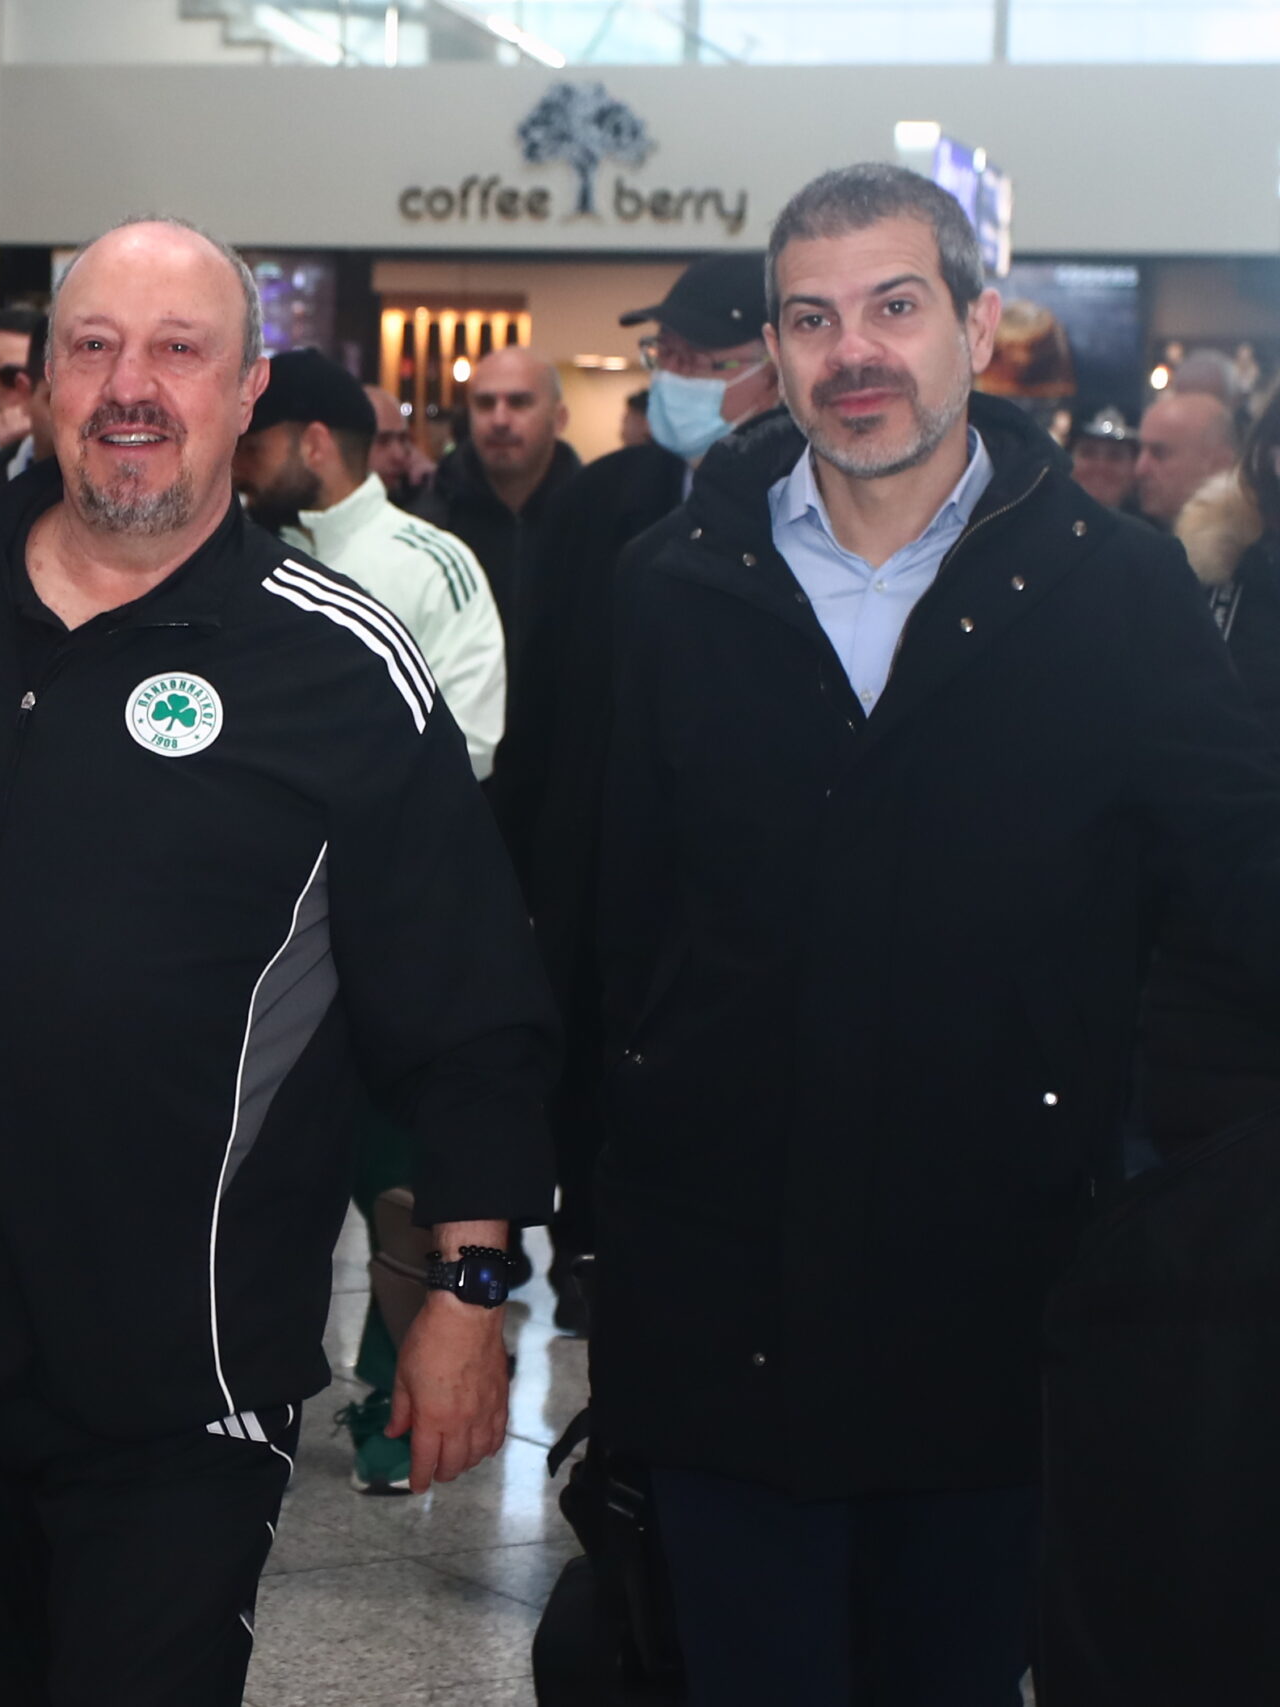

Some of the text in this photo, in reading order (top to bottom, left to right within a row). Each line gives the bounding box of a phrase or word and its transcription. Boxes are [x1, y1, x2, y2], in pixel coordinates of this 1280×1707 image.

[398, 174, 749, 236] coffee berry
[151, 734, 178, 749] 1908
